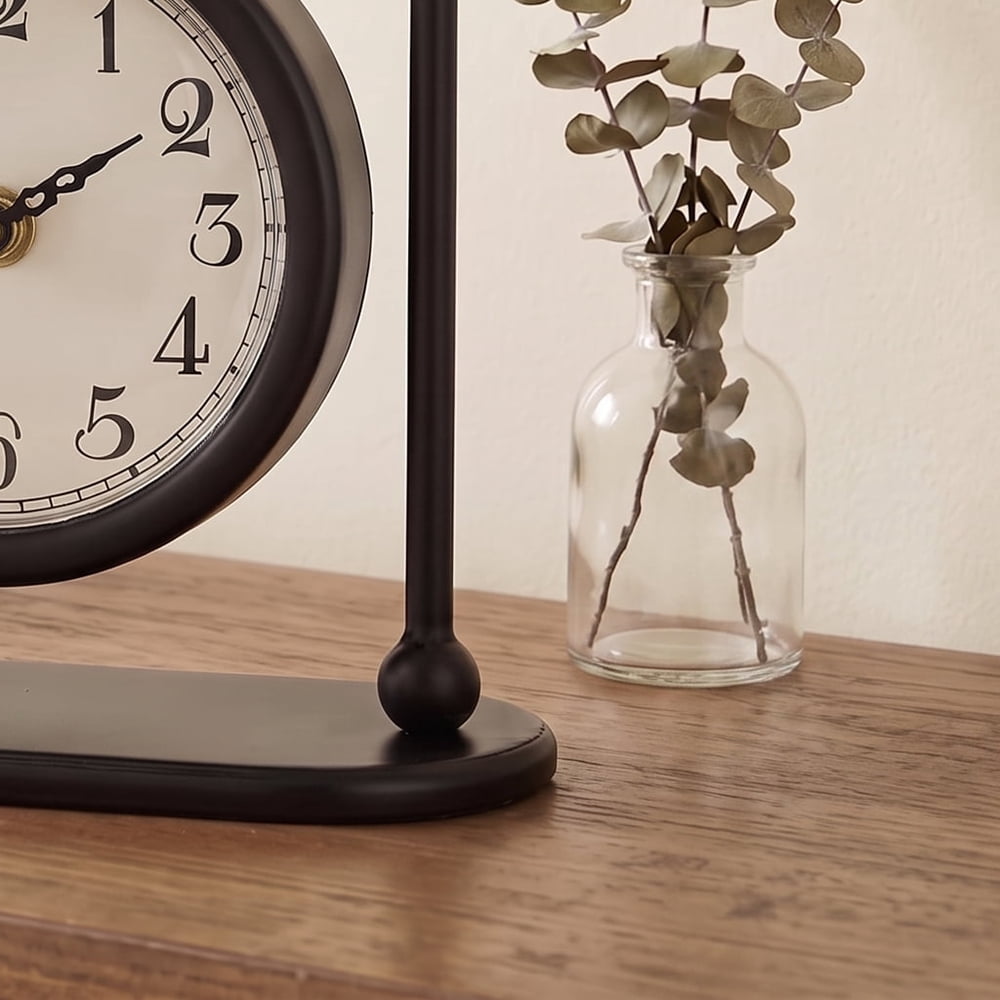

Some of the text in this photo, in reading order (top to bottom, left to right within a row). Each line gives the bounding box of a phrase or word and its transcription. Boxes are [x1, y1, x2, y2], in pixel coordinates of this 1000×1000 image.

[160, 77, 214, 158] 2
[189, 193, 243, 267] 3
[153, 296, 210, 375] 4
[75, 385, 136, 460] 5
